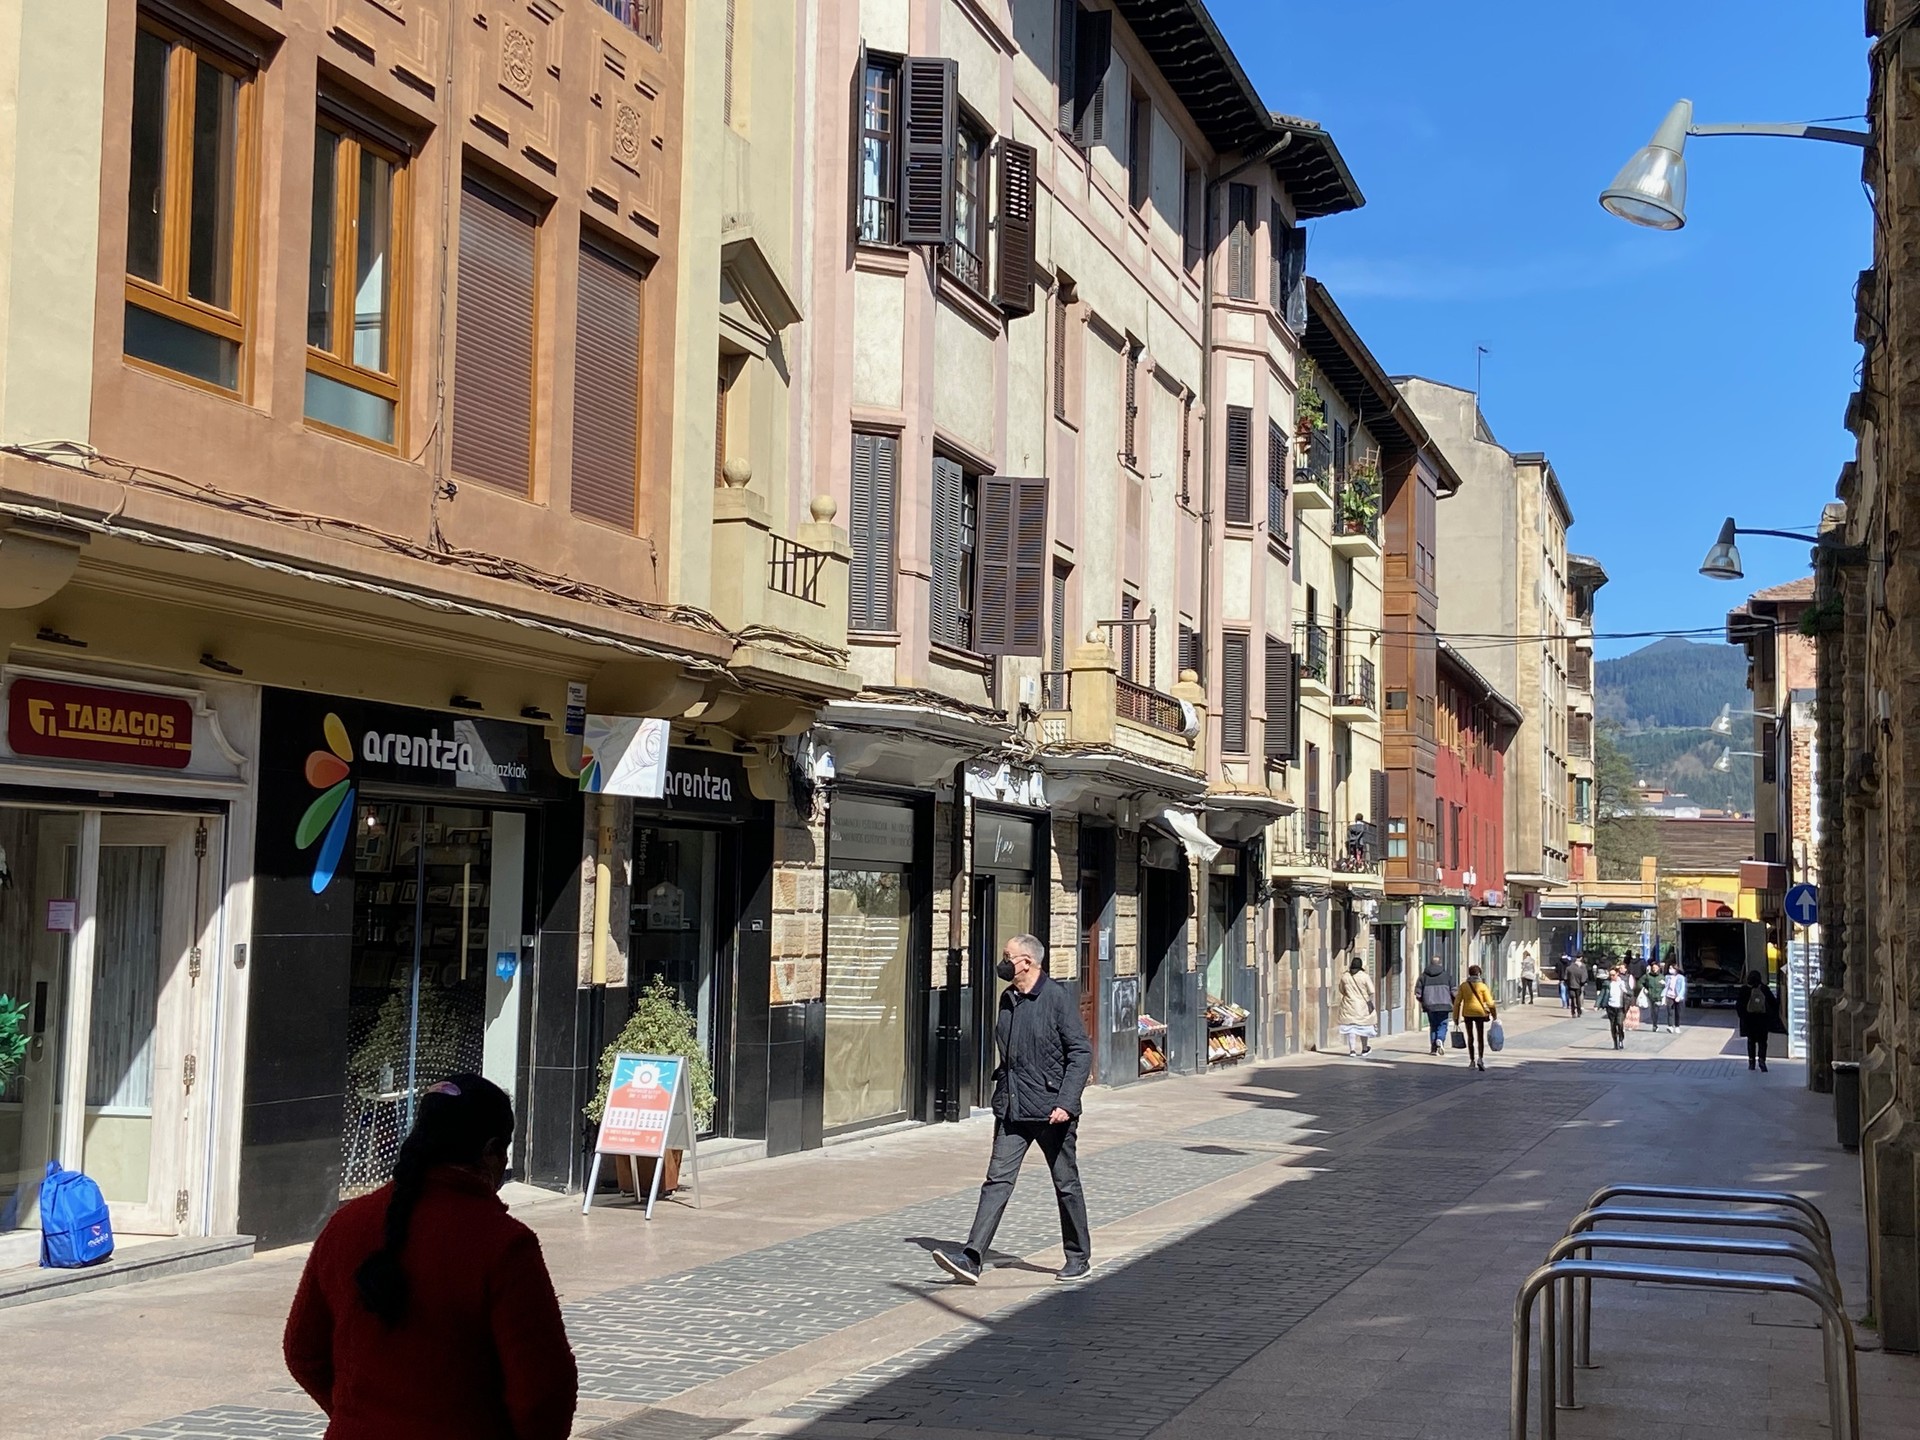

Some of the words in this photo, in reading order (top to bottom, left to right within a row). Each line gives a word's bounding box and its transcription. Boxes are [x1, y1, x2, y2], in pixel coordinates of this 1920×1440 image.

[65, 703, 175, 739] TABACOS
[362, 728, 475, 773] arentza
[480, 761, 527, 779] argazkiak
[664, 767, 732, 802] arentza
